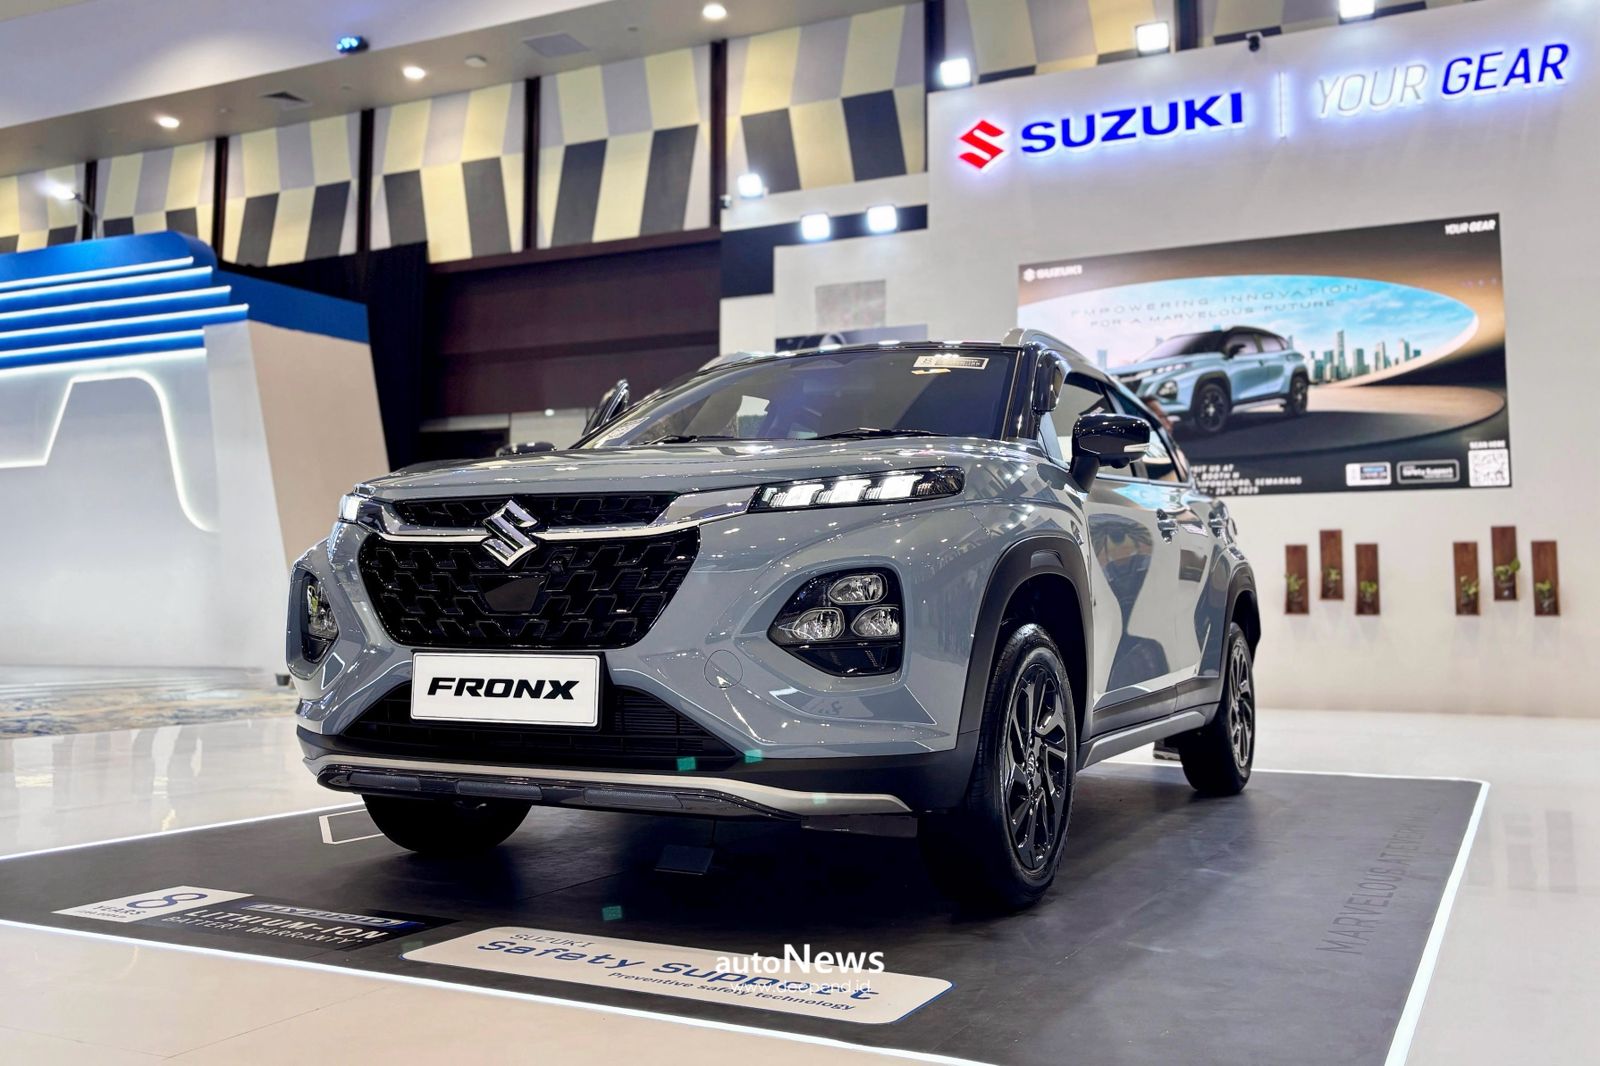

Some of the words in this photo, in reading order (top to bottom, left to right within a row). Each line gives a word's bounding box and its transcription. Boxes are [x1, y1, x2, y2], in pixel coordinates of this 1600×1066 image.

[1318, 64, 1428, 118] YOUR
[1441, 42, 1571, 96] GEAR
[1020, 92, 1245, 155] SUZUKI
[1445, 222, 1469, 234] YOUR
[1469, 219, 1496, 232] GEAR
[1036, 265, 1083, 279] SUZUKI
[1223, 284, 1359, 304] INNOVATION
[1090, 318, 1123, 328] FOR
[1149, 307, 1255, 323] MARVELOUS
[1263, 299, 1336, 312] FUTURE
[427, 676, 580, 701] FRONX
[126, 892, 209, 909] 8
[1315, 867, 1406, 955] MARVELOUS
[161, 915, 247, 931] BATTERY
[185, 909, 389, 940] LITHIUM-ION
[509, 933, 595, 948] SUZUKI
[477, 940, 645, 970] Safety
[652, 962, 880, 1000] Support
[608, 971, 694, 989] Preventive
[699, 984, 751, 996] safety
[755, 990, 856, 1011] technology
